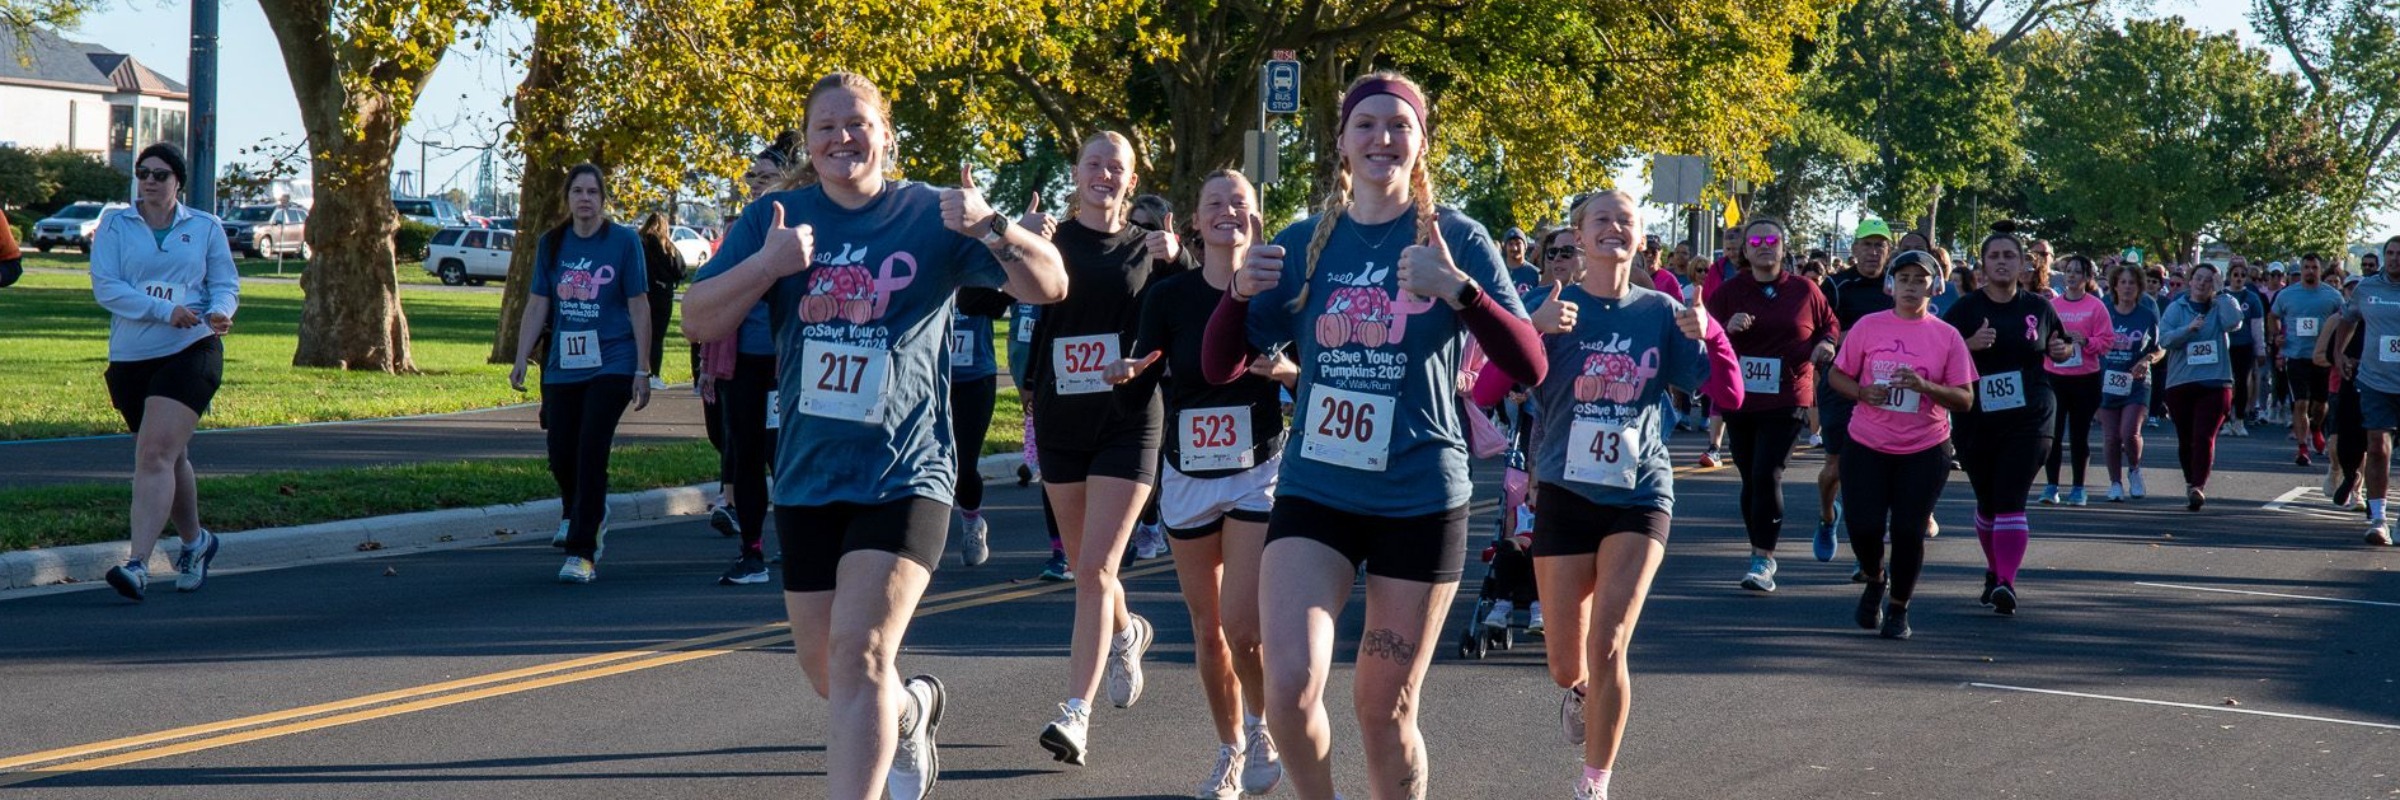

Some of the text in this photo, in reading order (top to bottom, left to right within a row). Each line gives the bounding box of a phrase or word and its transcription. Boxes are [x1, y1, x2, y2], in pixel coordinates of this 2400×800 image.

[1272, 101, 1293, 109] STOP
[1275, 92, 1291, 101] BUS
[145, 285, 173, 302] 104
[816, 323, 875, 339] Save Your
[566, 336, 587, 356] 117
[2192, 343, 2212, 357] 329
[1064, 341, 1107, 374] 522
[1331, 349, 1394, 365] Save Your
[1873, 360, 1897, 371] 2022
[816, 351, 869, 394] 217
[1321, 363, 1376, 380] Pumpkins
[1745, 361, 1772, 381] 344
[1335, 379, 1391, 391] 5K Walk/Run
[1987, 376, 2015, 399] 485
[2108, 373, 2128, 388] 328
[1584, 402, 1611, 417] Save
[1318, 396, 1376, 443] 296
[1192, 414, 1237, 449] 523
[1589, 430, 1621, 464] 43
